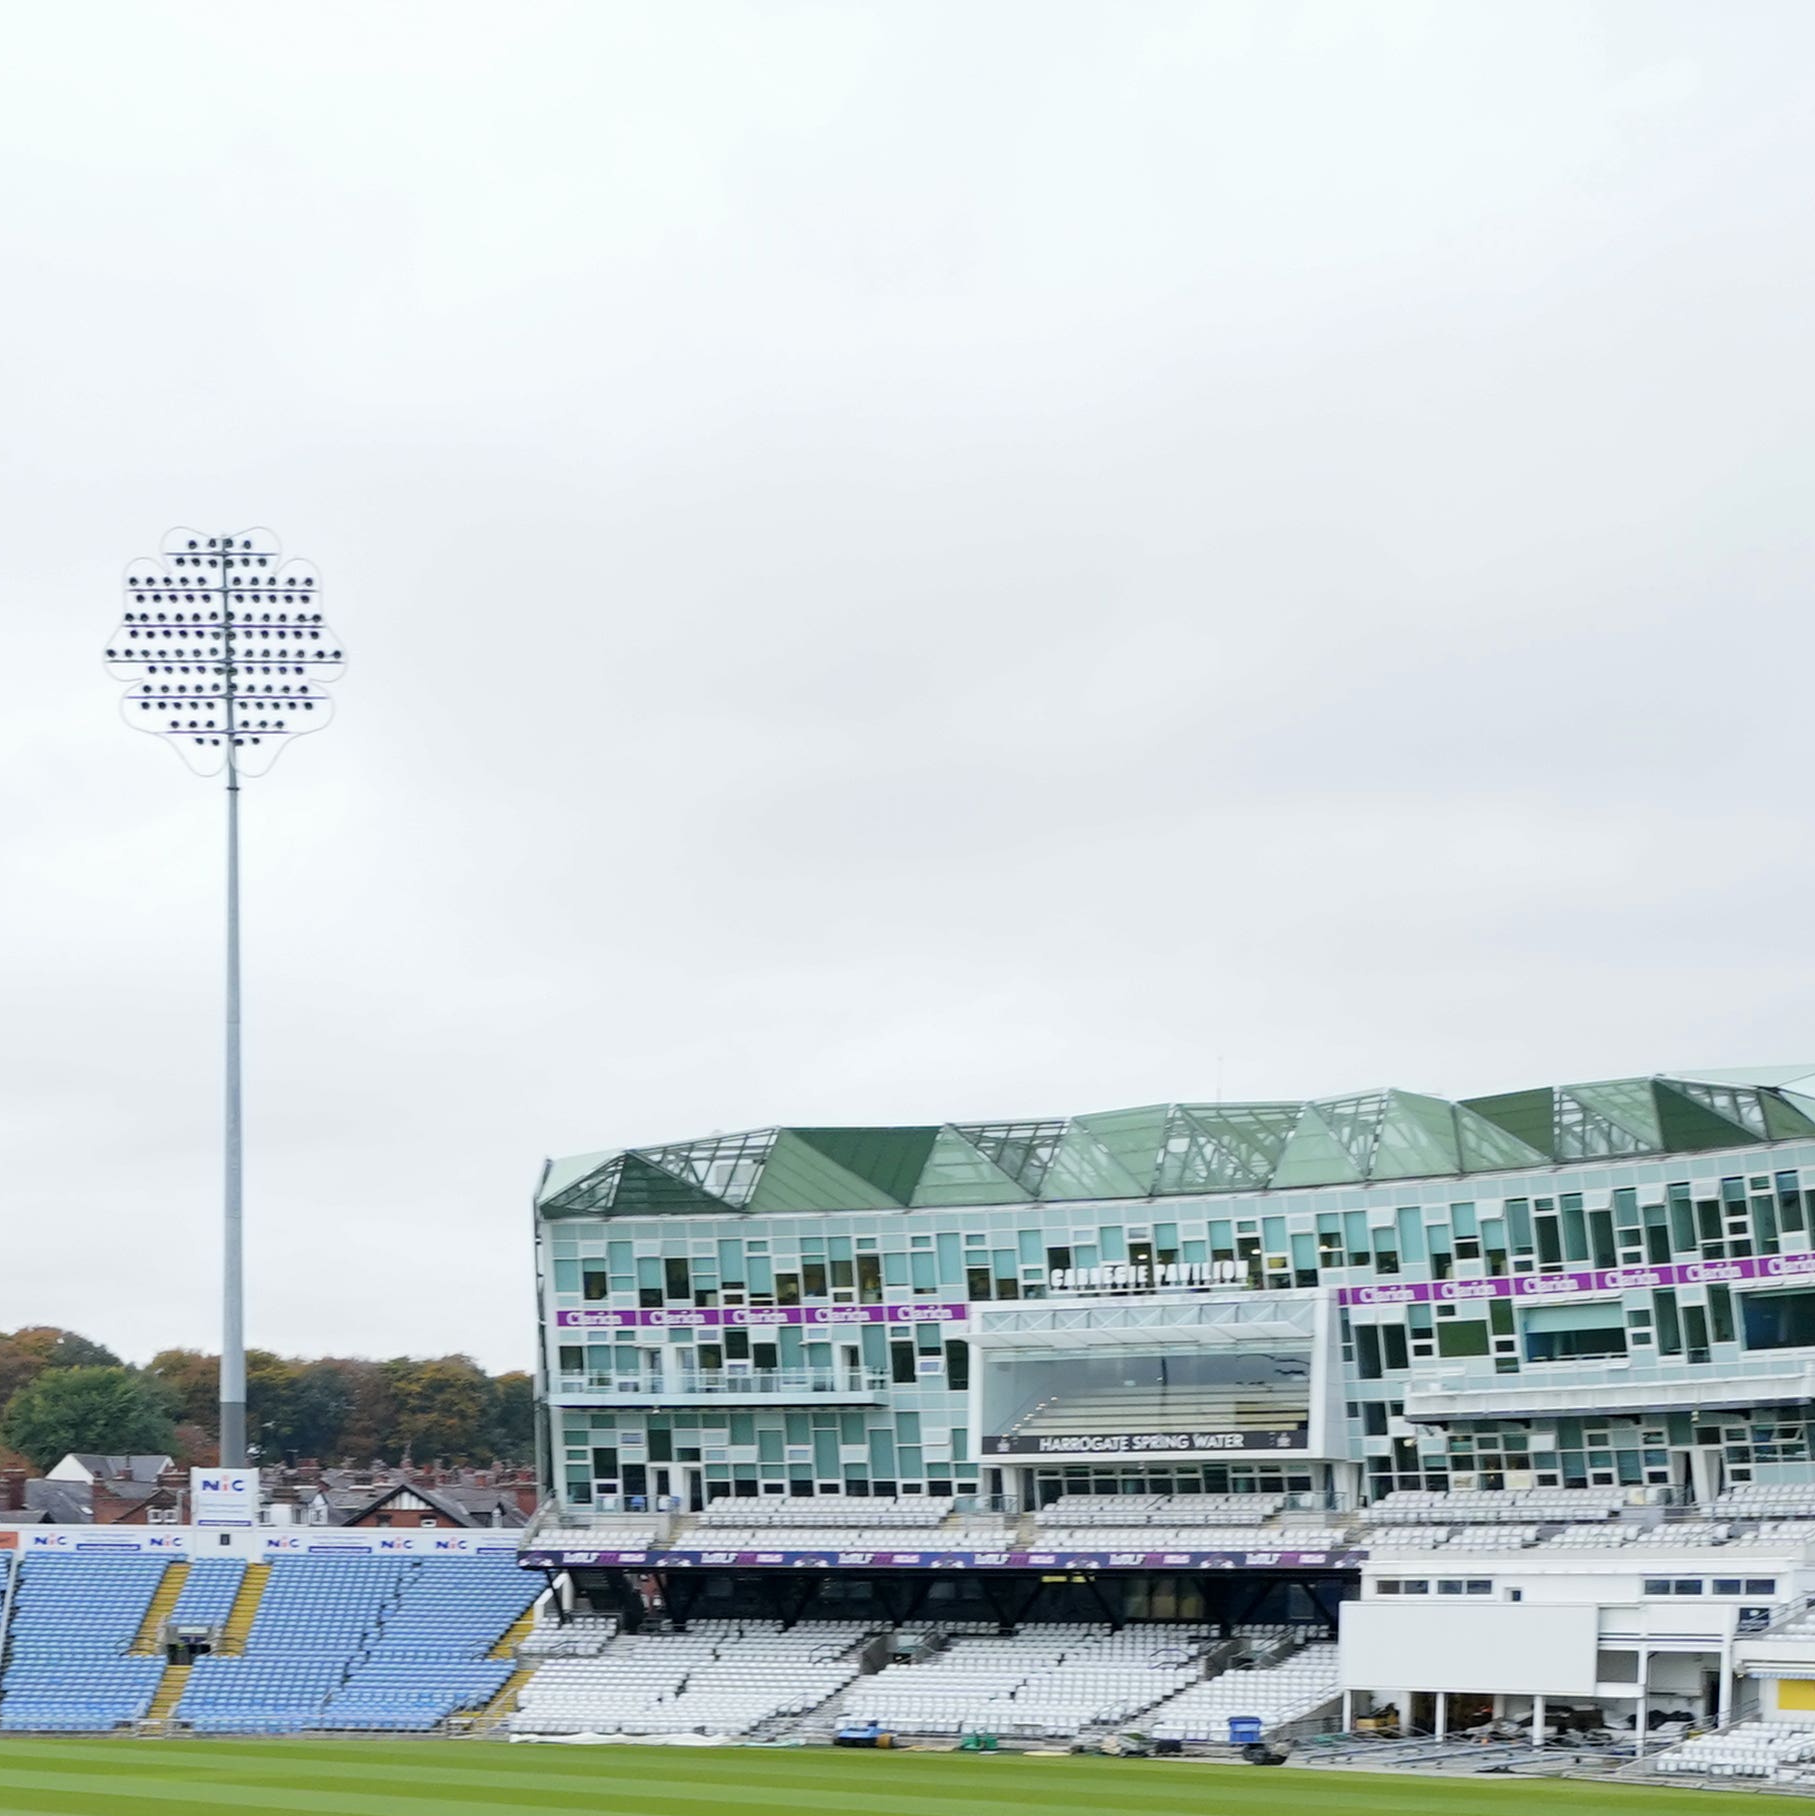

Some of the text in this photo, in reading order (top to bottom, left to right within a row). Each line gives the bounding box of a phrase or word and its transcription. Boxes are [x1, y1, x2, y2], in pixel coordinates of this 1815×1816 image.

[1050, 1260, 1249, 1287] CARNEGIE PAVILION
[1605, 1270, 1661, 1288] Clarion
[1686, 1263, 1742, 1281] Clarion
[1441, 1281, 1497, 1299] Clarion
[1523, 1276, 1579, 1294] Clarion
[1359, 1286, 1414, 1303] Clarion
[566, 1311, 622, 1326] Clarion
[649, 1310, 706, 1325] Clarion
[733, 1308, 788, 1324] Clarion
[815, 1307, 871, 1322] Clarion
[897, 1305, 953, 1321] Clarion
[1039, 1433, 1245, 1451] HARROGATE SPRING WATER
